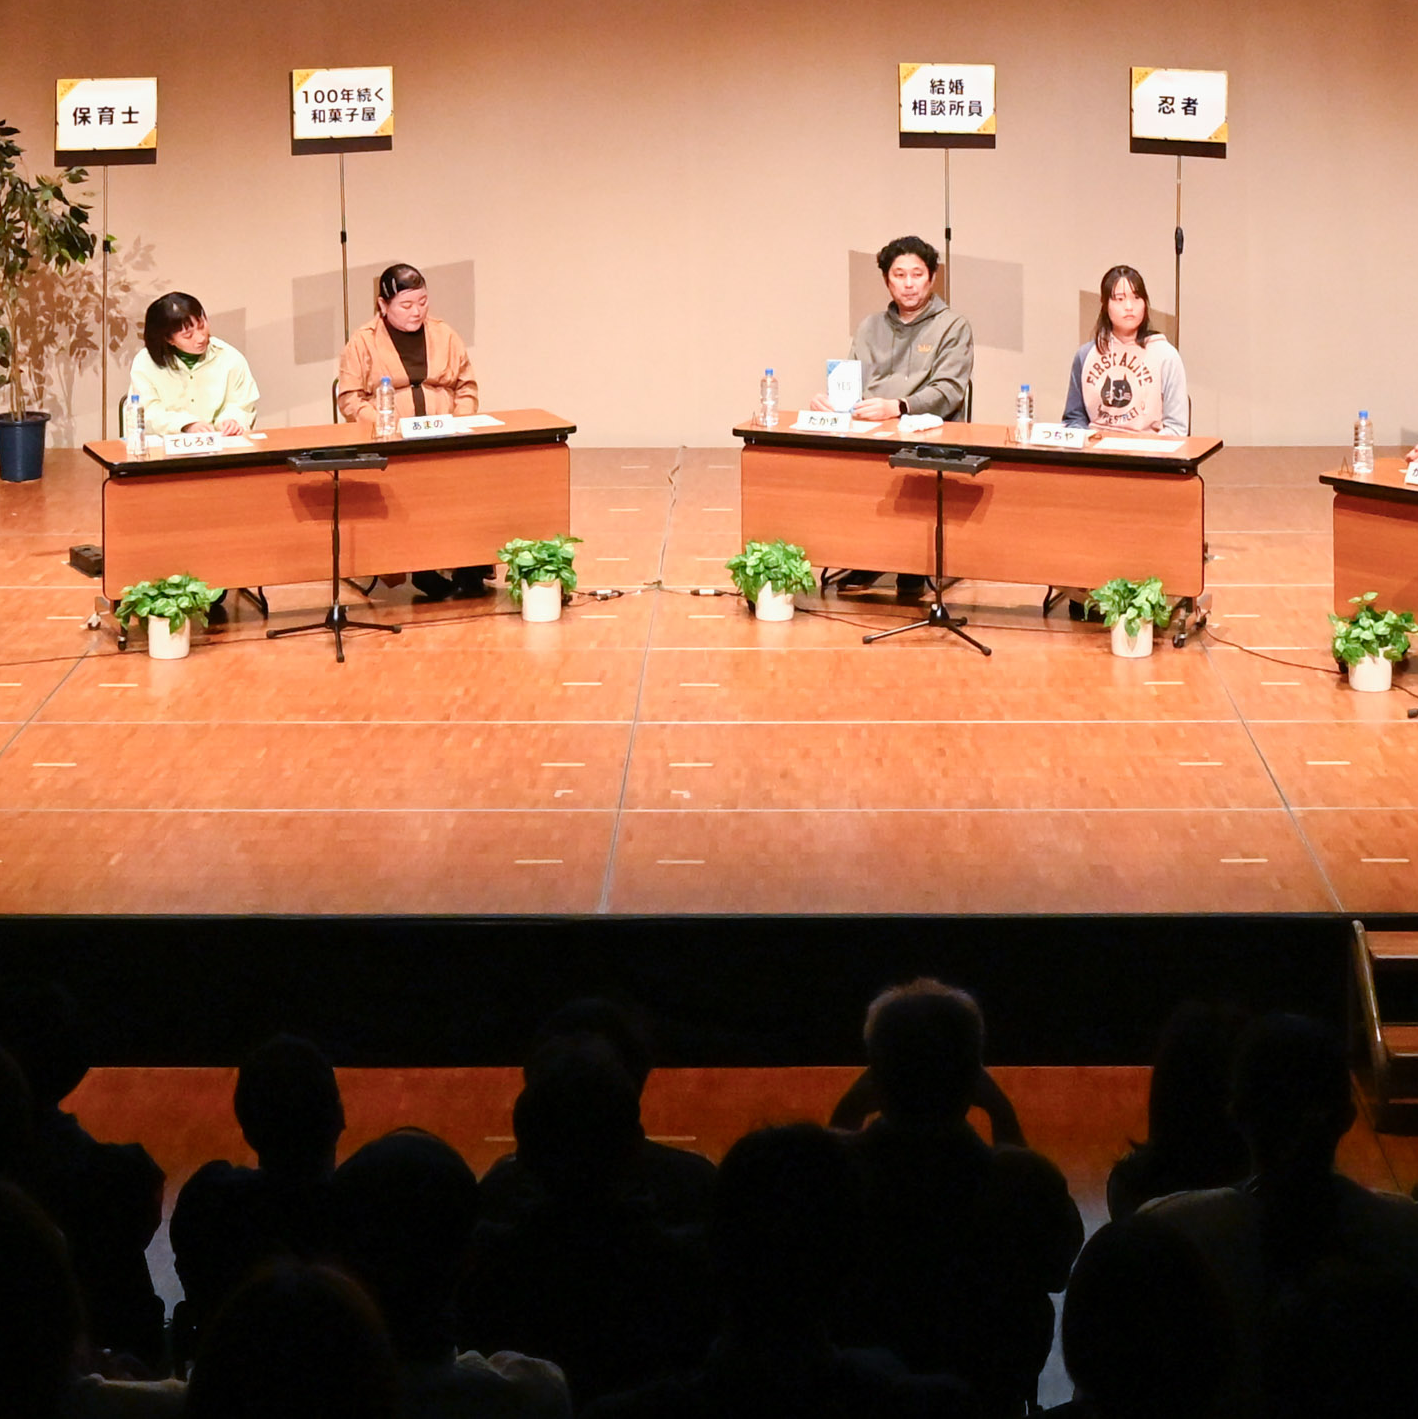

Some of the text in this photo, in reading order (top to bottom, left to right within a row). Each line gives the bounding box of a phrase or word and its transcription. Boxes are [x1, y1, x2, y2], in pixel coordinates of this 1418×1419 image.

[301, 87, 385, 104] 100年続く
[929, 78, 965, 95] 結婚
[911, 99, 983, 117] 相談所員
[1157, 95, 1199, 116] 忍者
[72, 106, 140, 126] 保育士
[311, 106, 377, 124] 和菓子屋
[1086, 352, 1117, 386] FIRST
[412, 419, 443, 431] あまの
[1042, 431, 1075, 441] つちや
